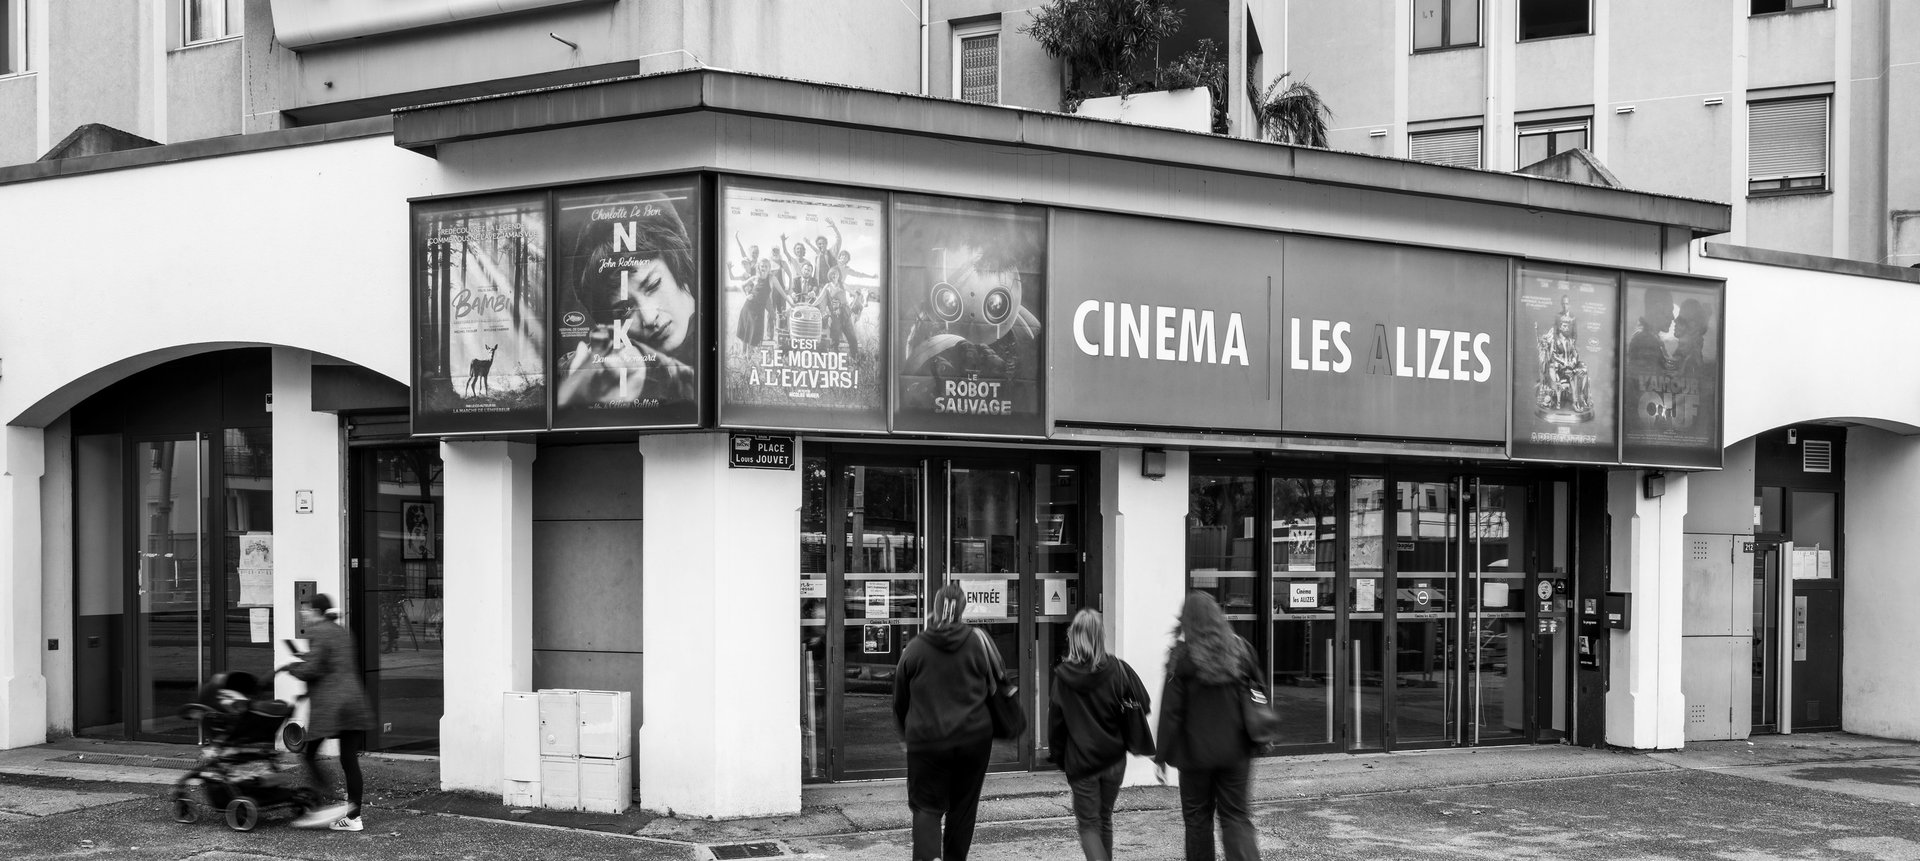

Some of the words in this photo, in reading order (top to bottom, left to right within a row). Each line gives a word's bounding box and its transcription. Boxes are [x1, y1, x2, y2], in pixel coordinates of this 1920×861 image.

[591, 206, 627, 221] Charlotte
[630, 204, 641, 218] Le
[643, 204, 661, 216] Bon
[598, 257, 616, 273] John
[451, 288, 511, 320] BAMBI
[791, 338, 819, 350] C'EST
[1072, 299, 1250, 367] CINEMA
[1290, 317, 1353, 374] LES
[1365, 322, 1493, 383] ALIZES
[760, 349, 784, 367] LE
[788, 350, 848, 371] MONDE
[749, 366, 761, 386] À
[967, 373, 978, 381] LE
[945, 380, 1001, 398] ROBOT
[934, 397, 1012, 416] SAUVAGE
[757, 442, 785, 453] PLACE
[756, 454, 789, 465] JOUVET
[967, 588, 1000, 604] ENTRÉE
